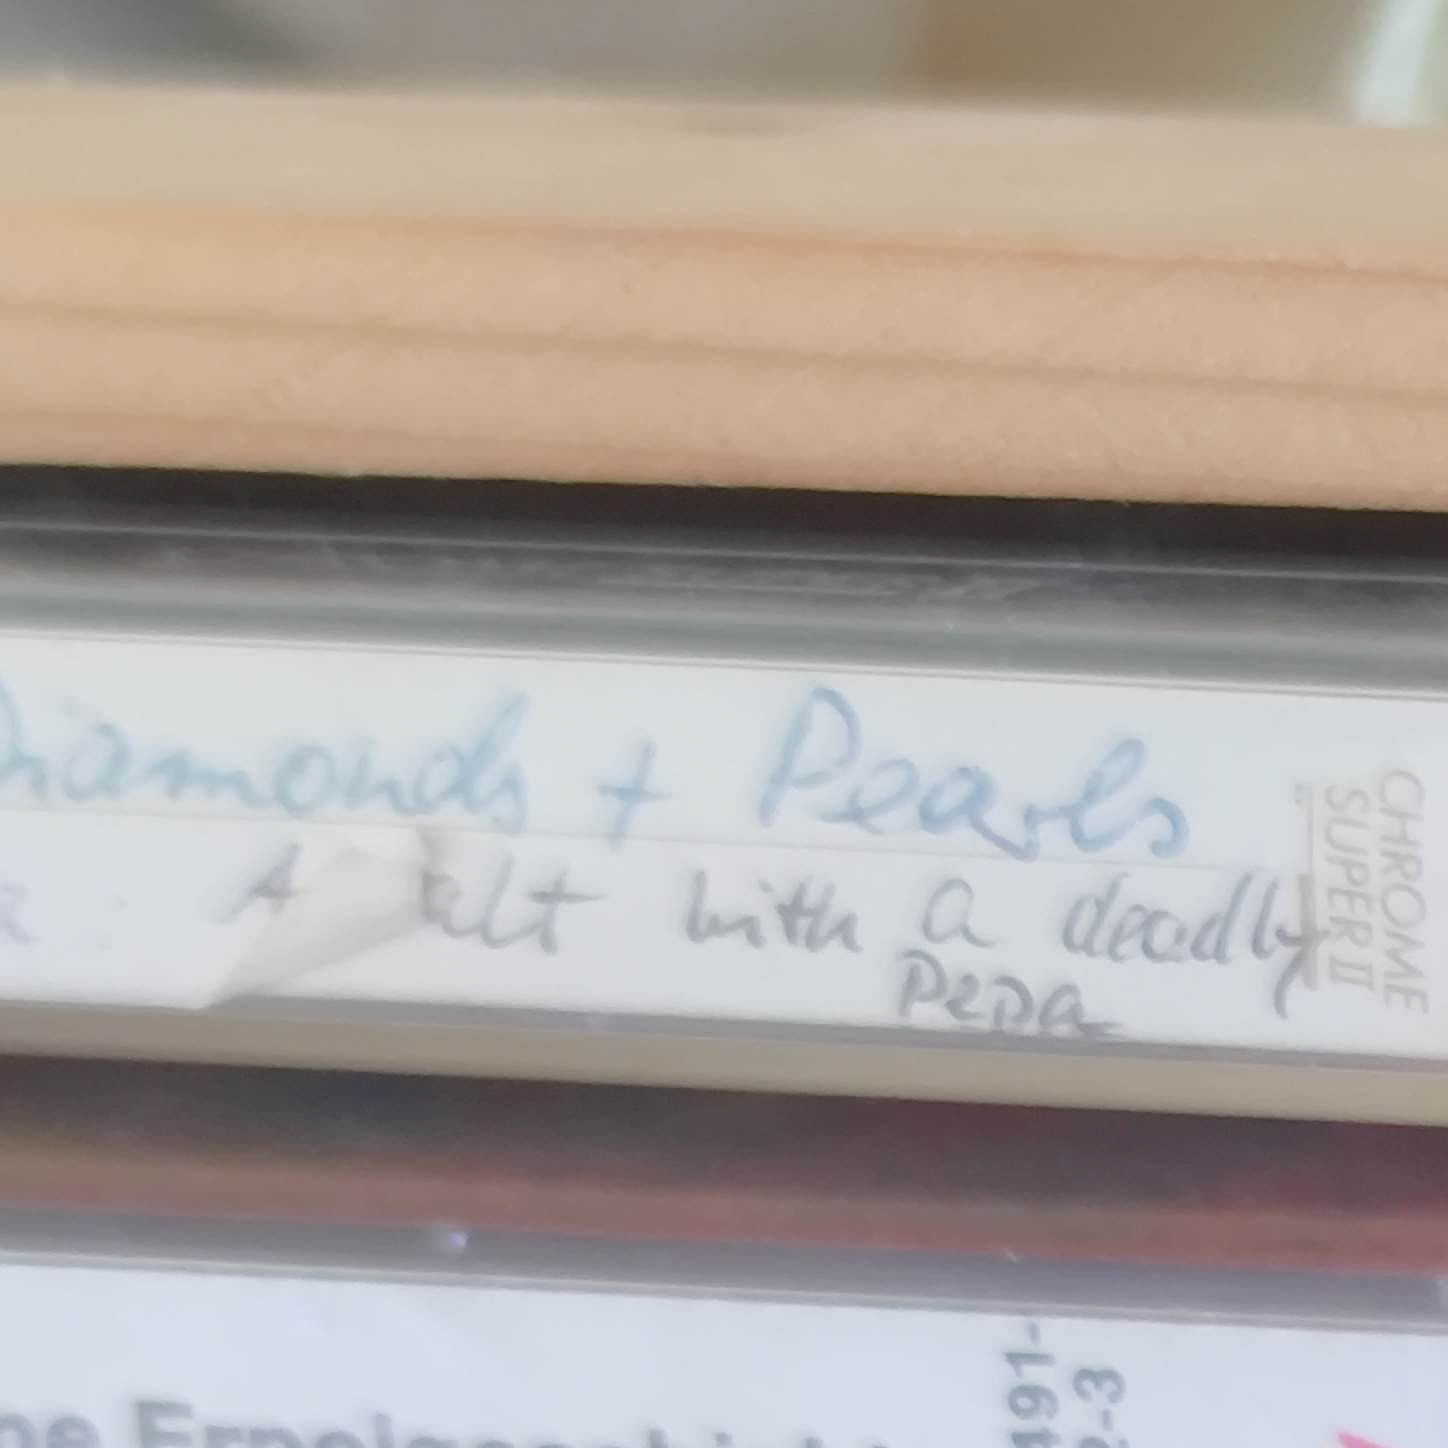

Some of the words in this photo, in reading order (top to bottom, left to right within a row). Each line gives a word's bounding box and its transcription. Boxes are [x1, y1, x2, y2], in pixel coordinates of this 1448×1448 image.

[0, 690, 527, 834] iamonds
[758, 684, 1190, 860] Pearls
[688, 868, 862, 953] with
[922, 876, 1007, 944] a
[1062, 866, 1325, 1020] deadly
[1324, 785, 1374, 948] SUPER
[1379, 770, 1428, 1014] CHROME
